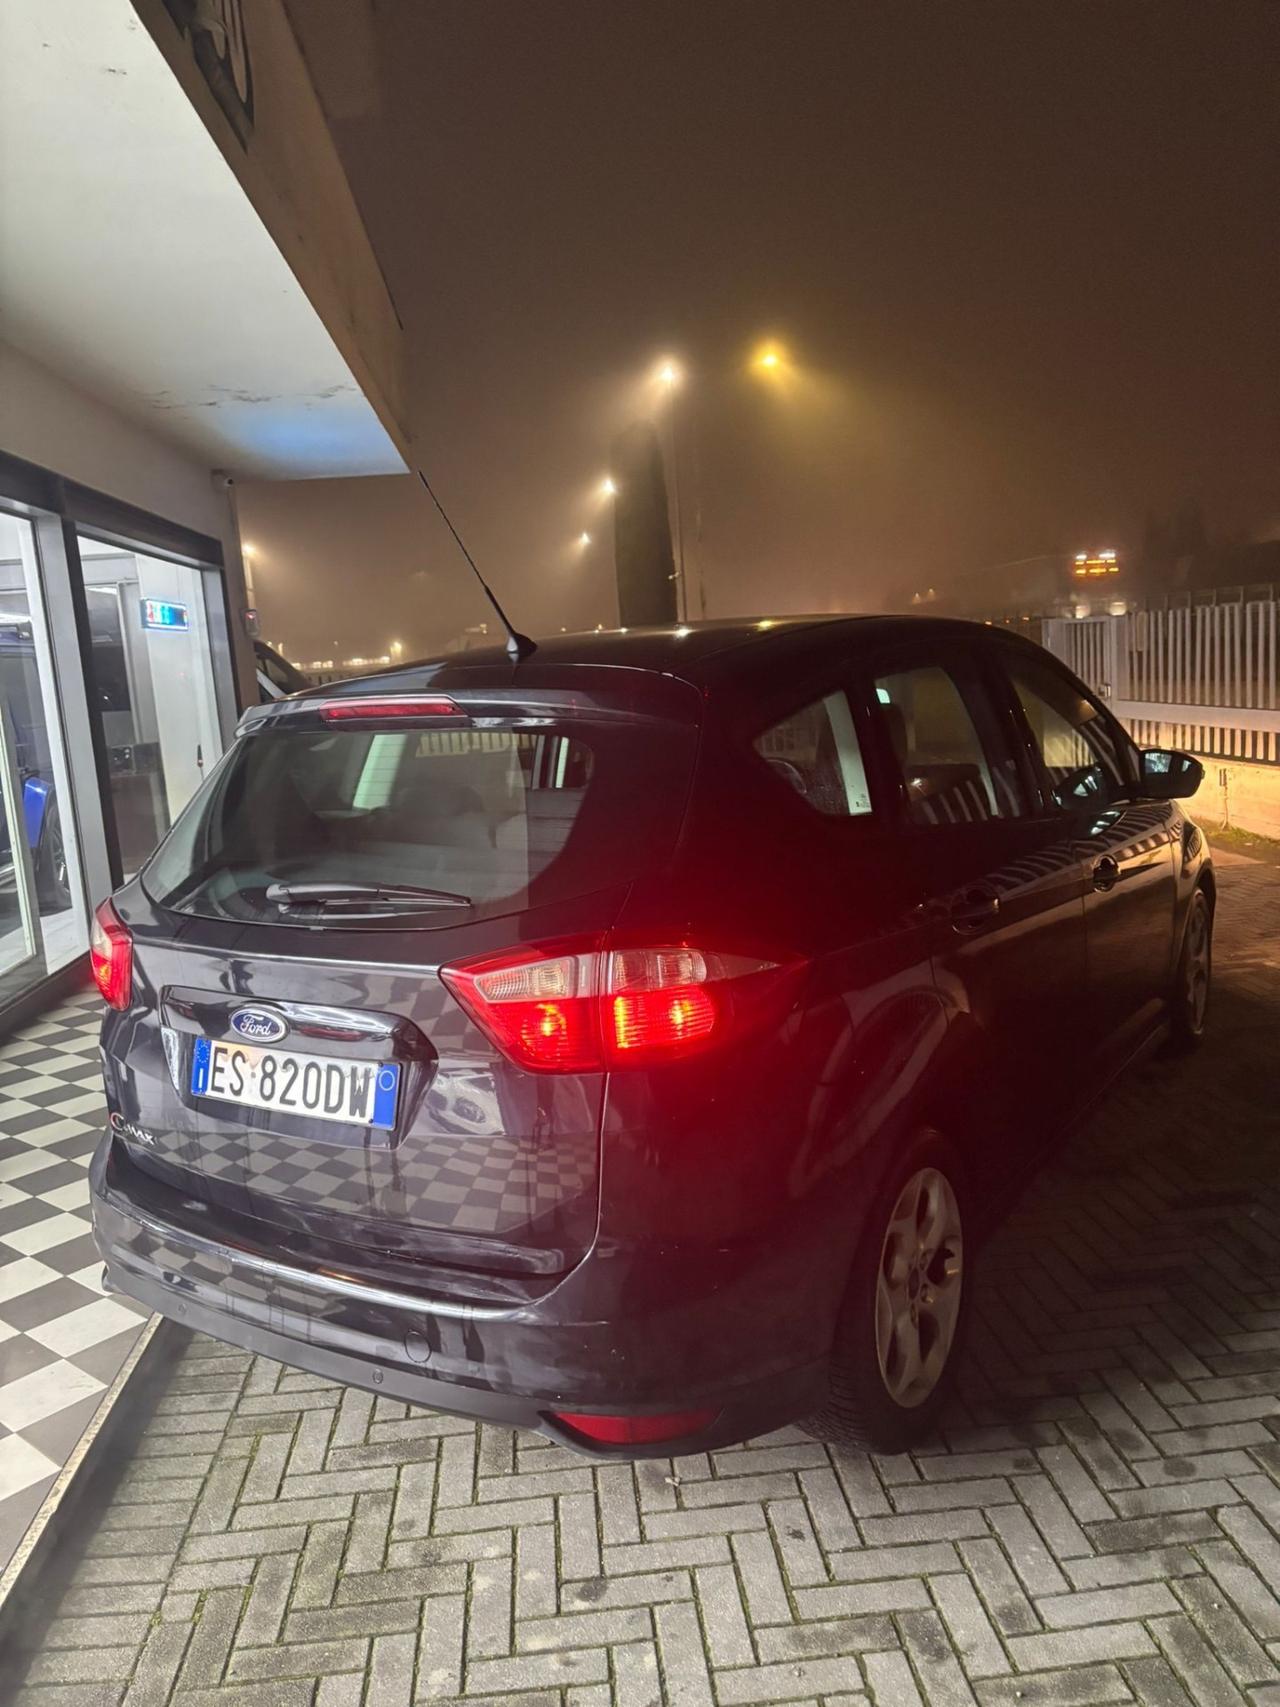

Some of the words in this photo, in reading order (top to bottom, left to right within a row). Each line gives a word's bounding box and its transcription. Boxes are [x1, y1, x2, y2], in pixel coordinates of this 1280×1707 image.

[239, 1014, 272, 1036] Ford
[210, 1046, 247, 1097] ES
[259, 1054, 372, 1118] 820DW
